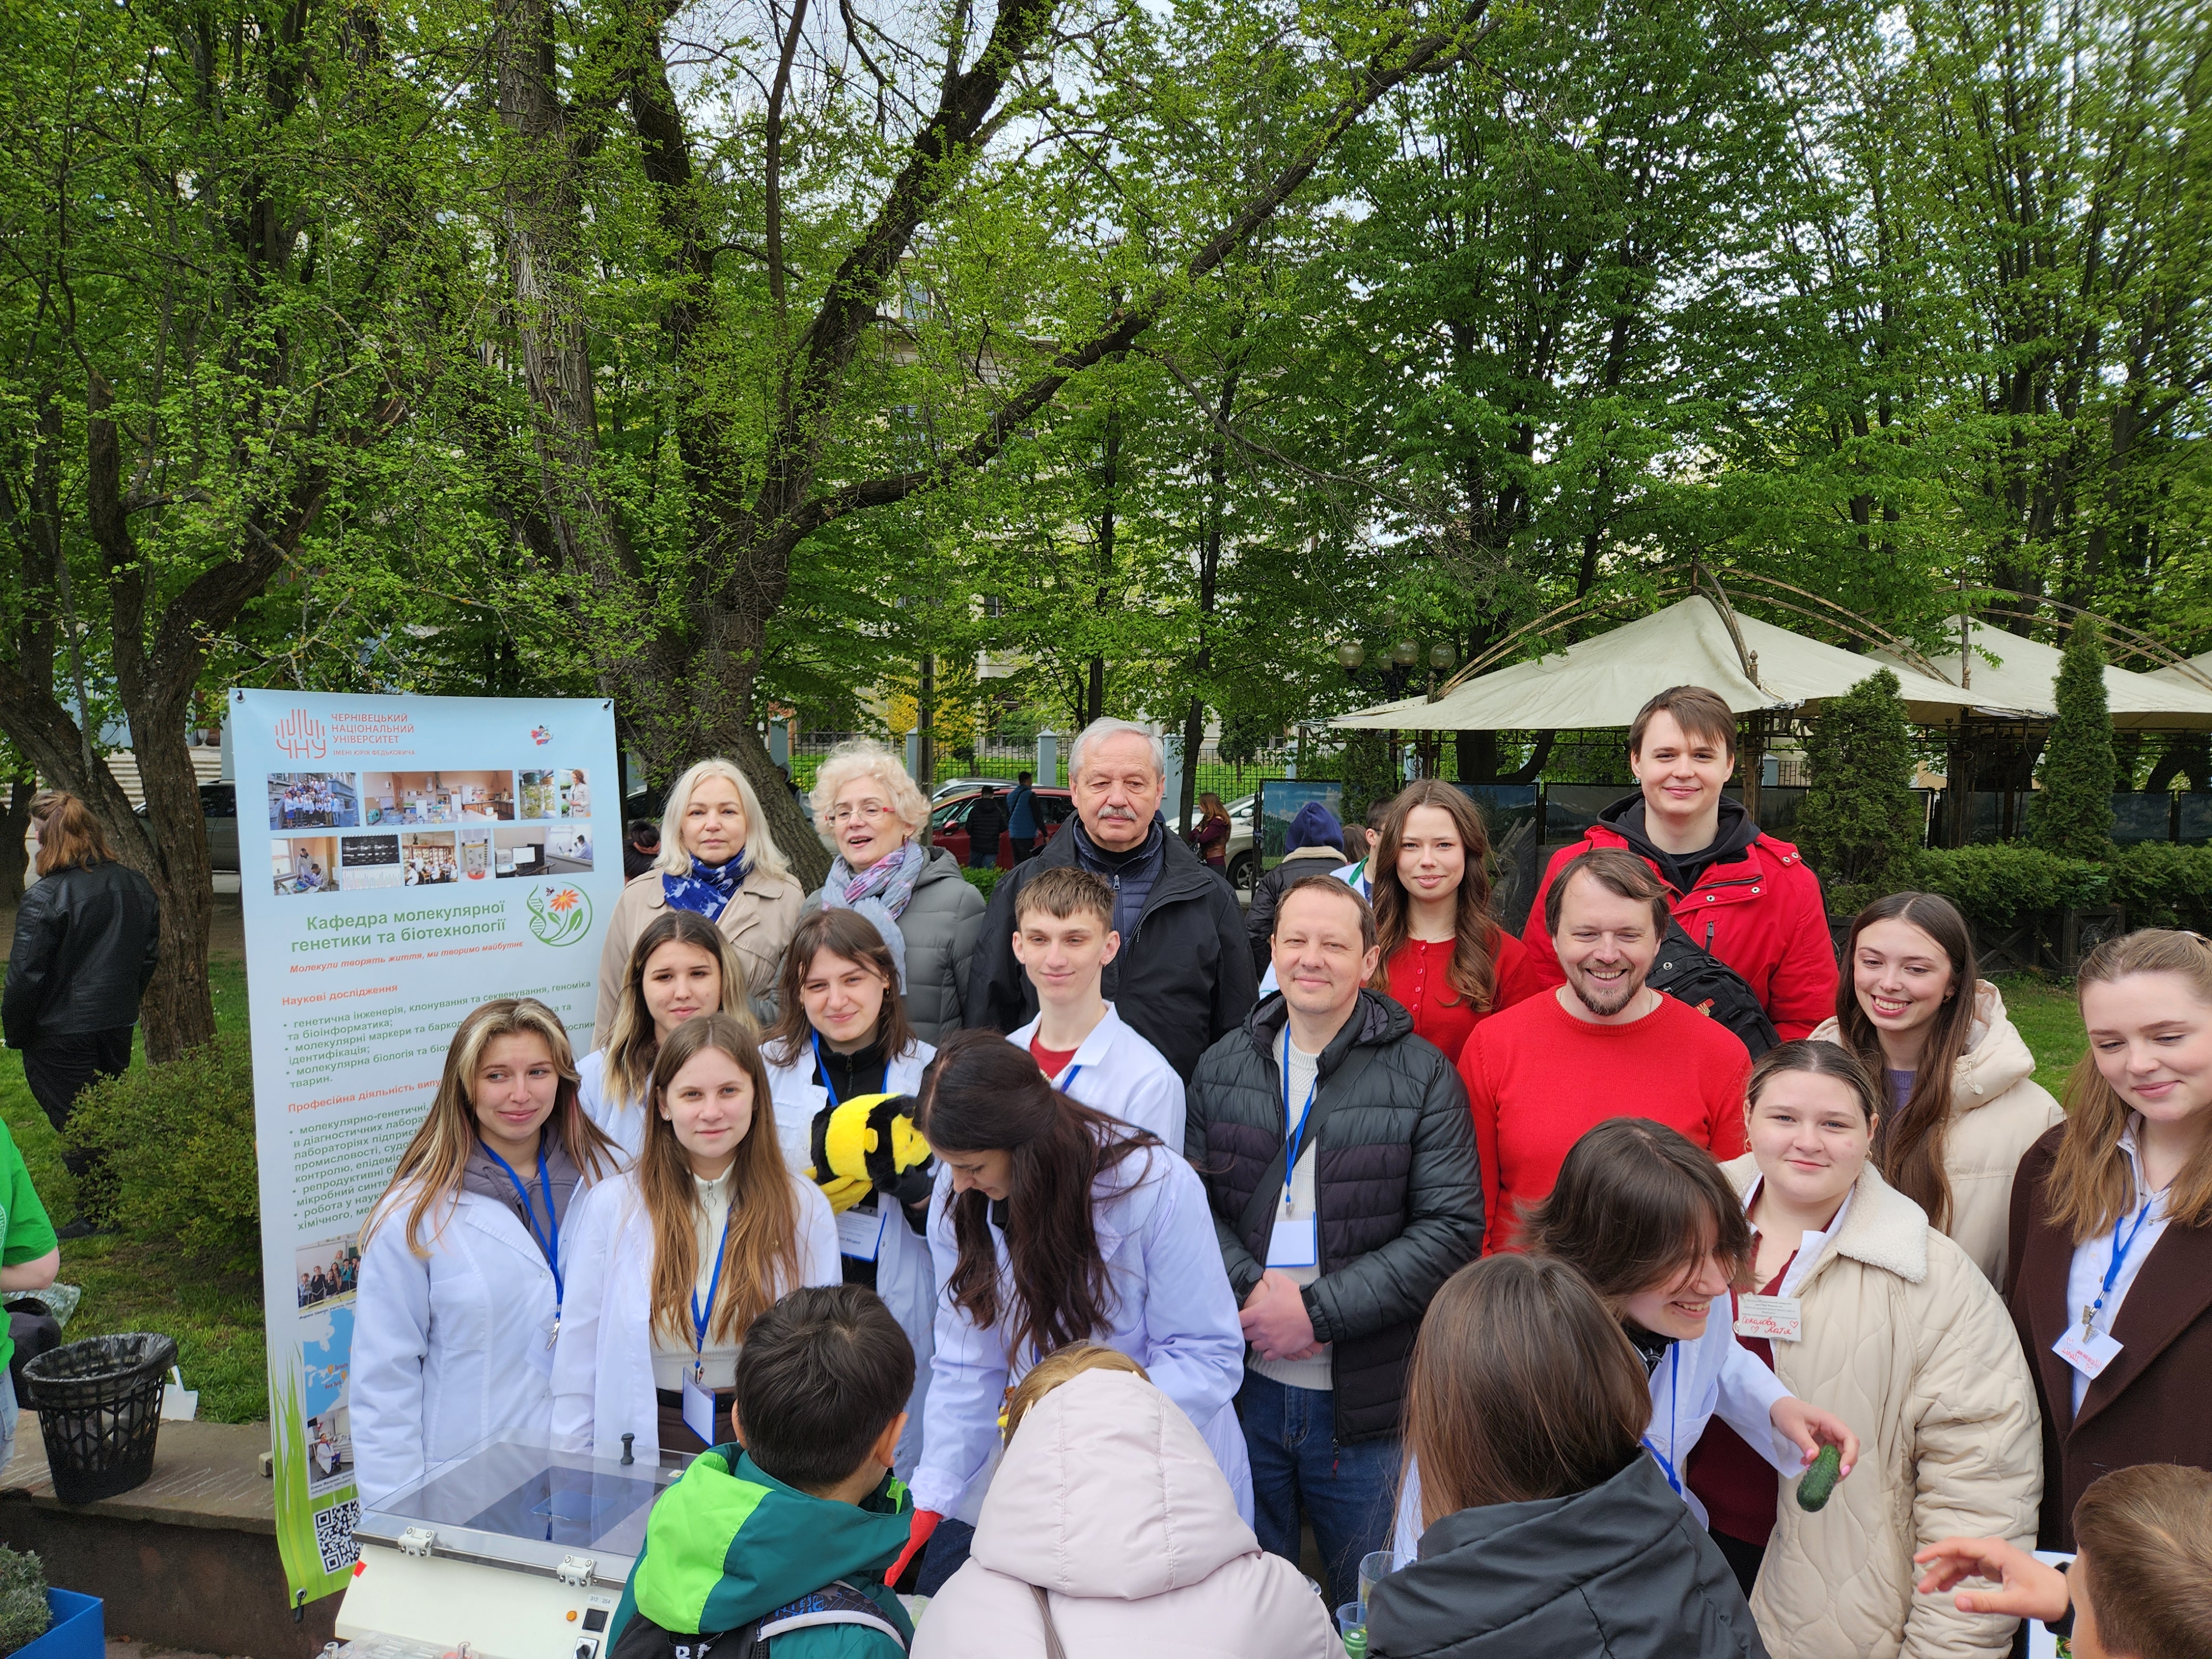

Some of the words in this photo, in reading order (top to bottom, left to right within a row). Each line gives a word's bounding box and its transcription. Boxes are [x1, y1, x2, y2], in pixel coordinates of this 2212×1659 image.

[331, 713, 408, 723] ЧЕРНІВЕЦЬКИЙ
[332, 723, 414, 734] НАЦІОНАЛЬНИЙ
[276, 739, 326, 759] ЧНУ
[333, 735, 399, 744] УНІВЕРСИТЕТ
[307, 912, 388, 931] Кафедра
[394, 900, 505, 924] молекулярної
[291, 933, 372, 952] генетики
[377, 931, 395, 943] та
[400, 919, 506, 942] біотехнології
[290, 962, 338, 974] Молекули
[341, 956, 386, 969] творять
[388, 952, 425, 963] життя,
[426, 950, 439, 958] ми
[441, 945, 480, 957] творимо
[482, 940, 524, 953] майбутнє
[282, 992, 326, 1007] Наукові
[330, 984, 398, 1001] дослідження
[294, 1013, 351, 1029] генетична
[353, 1005, 406, 1020] інженерія,
[409, 998, 468, 1013] клонування
[483, 987, 550, 1003] секвенування,
[552, 980, 591, 992] геноміка
[295, 1034, 366, 1052] молекулярні
[369, 1027, 411, 1041] маркери
[428, 1020, 463, 1032] баркод
[302, 1020, 393, 1040] біоінформатика;
[289, 1046, 370, 1066] ідентифікація;
[296, 1058, 370, 1076] молекулярна
[373, 1050, 414, 1063] біологія
[290, 1076, 333, 1089] тварин.
[288, 1094, 356, 1114] Професійна
[358, 1084, 415, 1102] діяльність
[300, 1102, 429, 1135] молекулярно-генетичні,
[303, 1124, 383, 1147] діагностичних
[294, 1138, 369, 1160] лабораторіях
[295, 1146, 381, 1171] промисловості,
[295, 1165, 353, 1183] контролю,
[303, 1167, 383, 1195] репродуктивні
[296, 1185, 354, 1207] мікробний
[304, 1201, 343, 1219] робота
[346, 1199, 352, 1208] у
[298, 1211, 353, 1231] хімічного,
